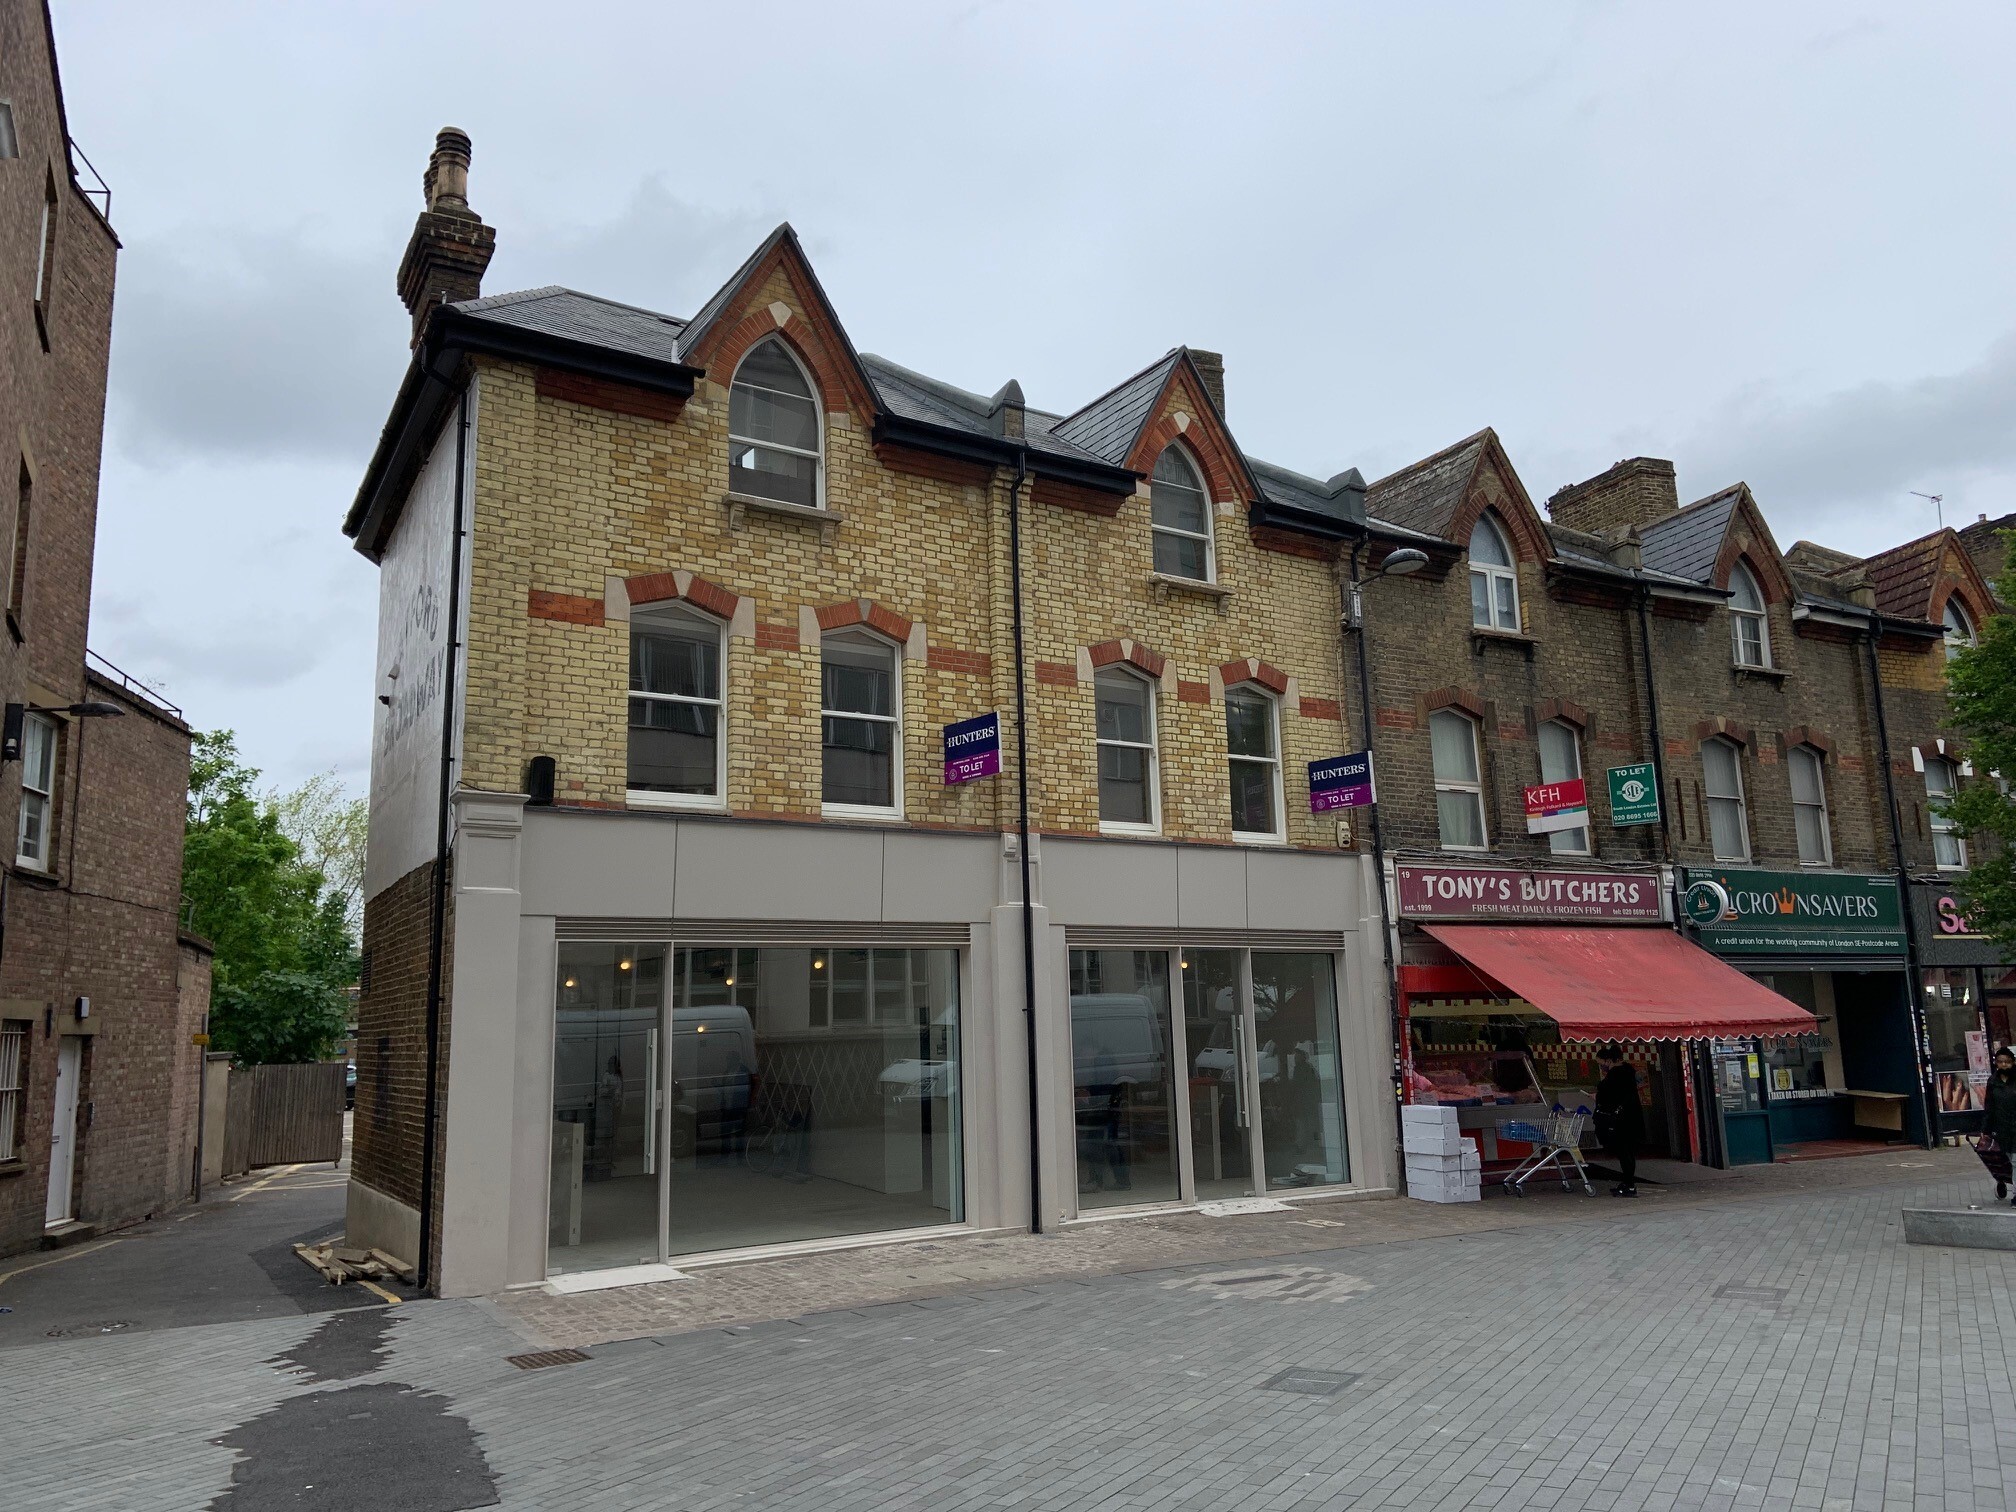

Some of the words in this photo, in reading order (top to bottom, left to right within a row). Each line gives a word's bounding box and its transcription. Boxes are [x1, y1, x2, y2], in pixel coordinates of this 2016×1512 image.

[946, 726, 995, 748] HUNTERS
[959, 764, 970, 774] TO
[971, 761, 984, 771] LET
[1311, 763, 1366, 781] HUNTERS
[1615, 769, 1627, 777] TO
[1629, 767, 1646, 775] LET
[1527, 787, 1560, 805] KFH
[1627, 785, 1639, 797] SLE
[1328, 796, 1339, 804] TO
[1340, 793, 1355, 802] LET
[1401, 871, 1410, 879] 19
[1421, 875, 1511, 900] TONY'S
[1519, 877, 1640, 904] BUTCHERS
[1686, 886, 1700, 903] Credit
[1700, 885, 1717, 898] Union
[1417, 904, 1432, 912] 1999
[1472, 903, 1498, 913] FRESH
[1499, 904, 1521, 913] MEAT
[1522, 905, 1546, 914] DAILY
[1546, 906, 1552, 914] &
[1554, 906, 1584, 915] FROZEN
[1585, 906, 1602, 915] FISH
[1715, 937, 1720, 945] A
[1720, 937, 1738, 945] credit
[1738, 937, 1755, 945] union
[1755, 937, 1764, 945] for
[1765, 937, 1775, 946] the
[1775, 938, 1798, 947] working
[1798, 938, 1828, 948] community
[1835, 939, 1854, 947] London
[1792, 1089, 1809, 1099] STORED
